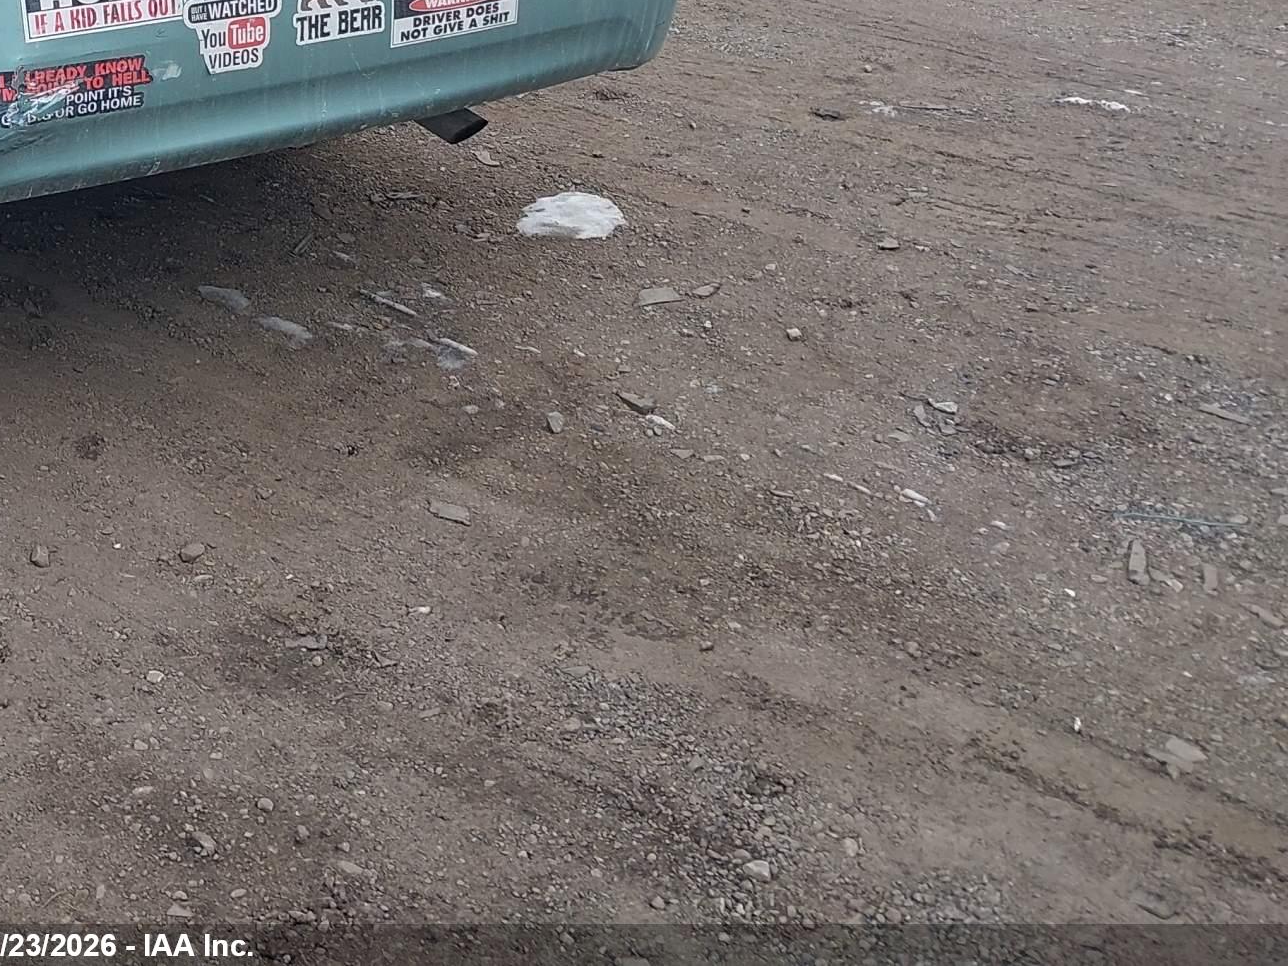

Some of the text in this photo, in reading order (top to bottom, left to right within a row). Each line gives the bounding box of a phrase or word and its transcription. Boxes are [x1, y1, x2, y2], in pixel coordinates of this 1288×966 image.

[34, 13, 49, 35] IF
[55, 12, 66, 29] A
[70, 7, 97, 29] KID
[103, 0, 143, 25] FALLS
[191, 13, 208, 22] HAVE
[296, 5, 383, 42] THE BEAR
[413, 3, 500, 28] DRIVER DOES
[400, 11, 510, 42] NOT GIVE A SHIT
[95, 58, 143, 76] KNOW
[209, 48, 260, 69] VIDEOS
[84, 76, 104, 91] TO
[112, 70, 151, 87] HELL
[66, 85, 132, 105] POINT IT'S
[77, 101, 97, 115] GO
[101, 95, 142, 111] HOME
